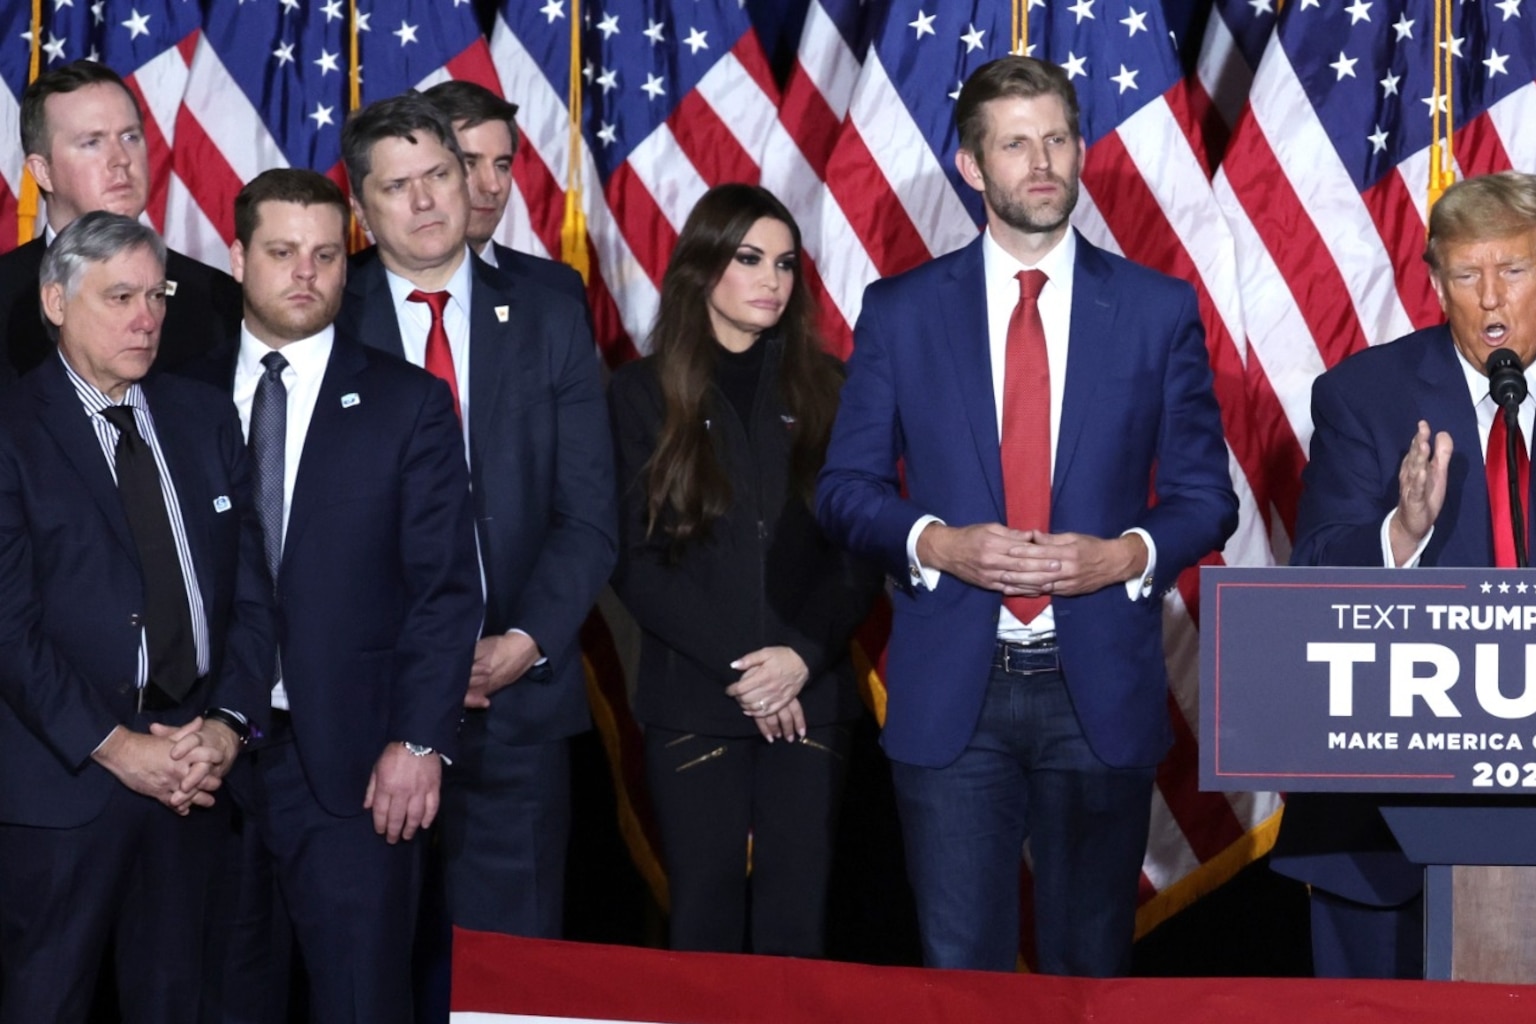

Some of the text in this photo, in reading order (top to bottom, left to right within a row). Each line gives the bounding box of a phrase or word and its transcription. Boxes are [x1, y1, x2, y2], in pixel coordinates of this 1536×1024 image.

[1331, 604, 1416, 630] TEXT
[1328, 731, 1399, 750] MAKE
[1407, 732, 1523, 751] AMERICA
